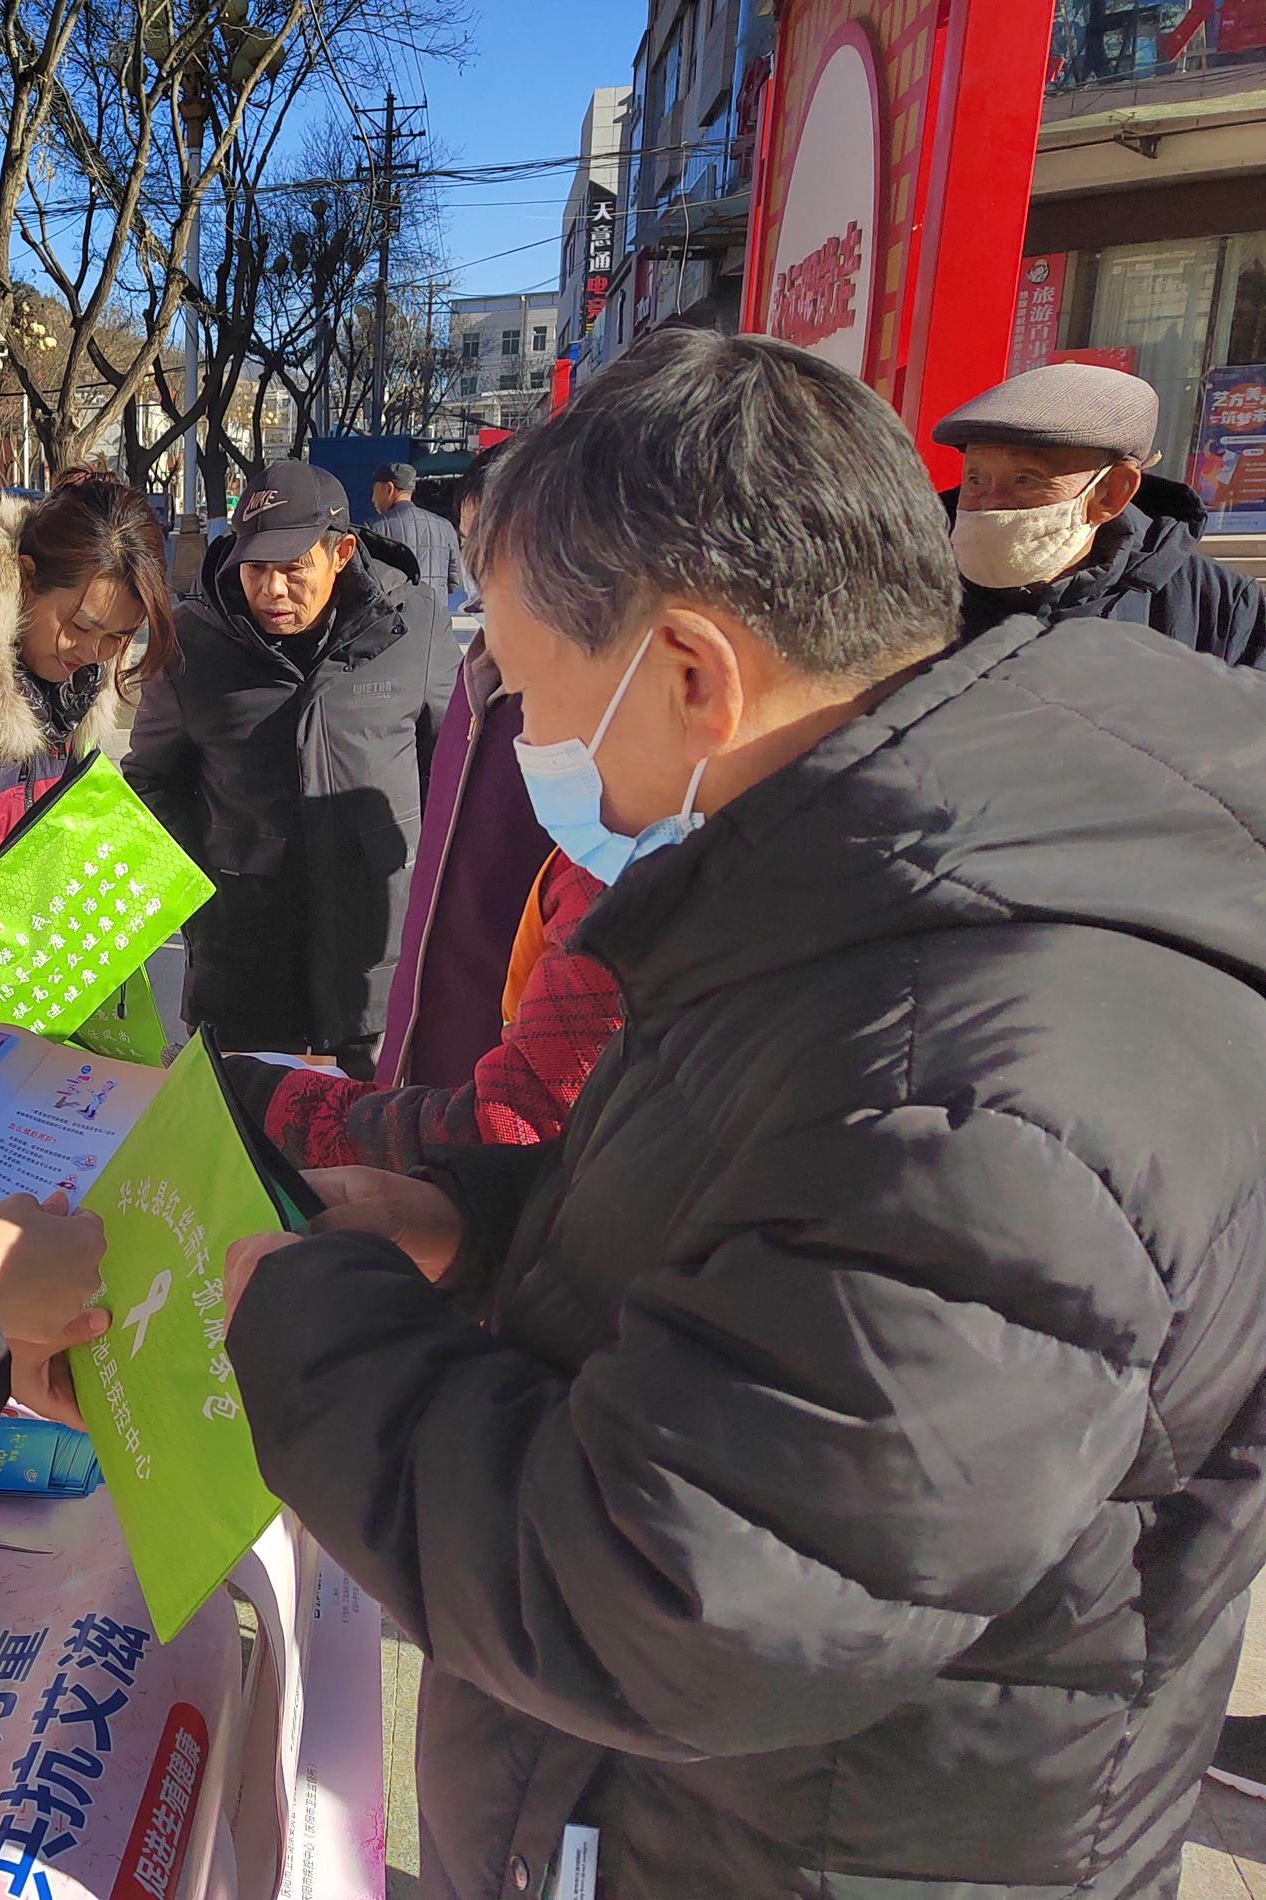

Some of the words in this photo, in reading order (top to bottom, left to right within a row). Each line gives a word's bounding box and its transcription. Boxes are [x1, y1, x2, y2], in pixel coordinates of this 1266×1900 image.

[249, 489, 279, 510] NIKE
[13, 876, 147, 1020] 提高公众健康素养
[30, 897, 162, 1035] 推进健康中国行动
[90, 1333, 152, 1480] 池县疾控中心
[132, 1726, 204, 1900] 促进生殖健康
